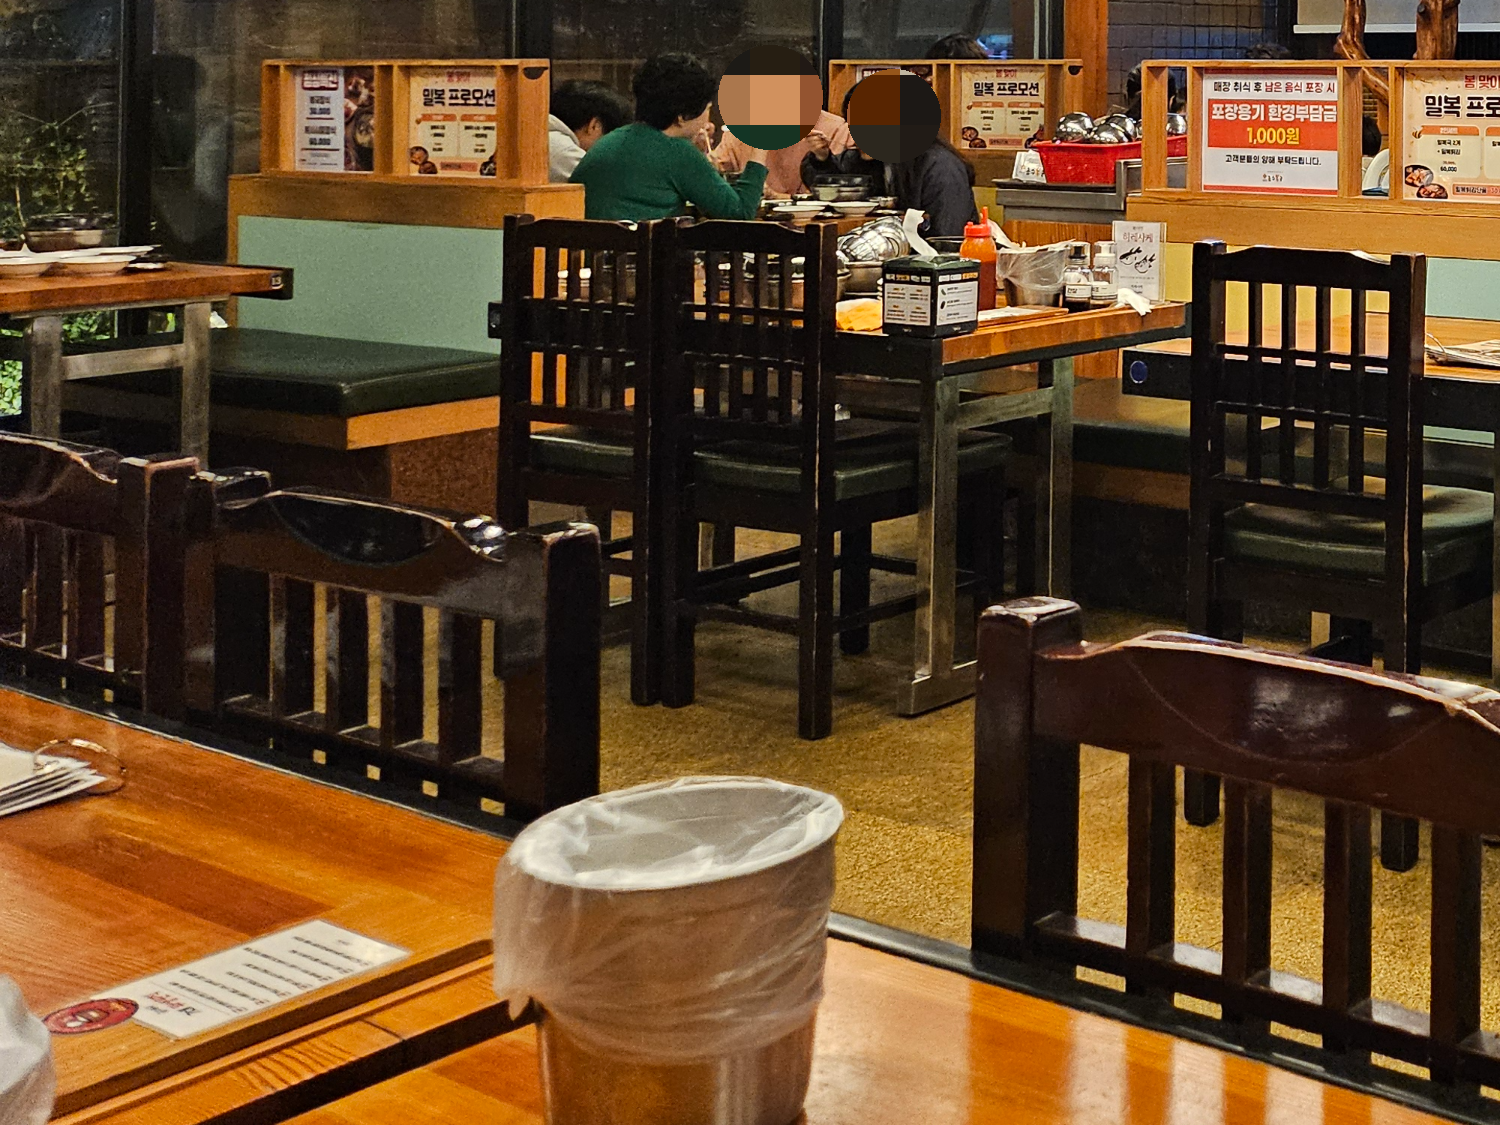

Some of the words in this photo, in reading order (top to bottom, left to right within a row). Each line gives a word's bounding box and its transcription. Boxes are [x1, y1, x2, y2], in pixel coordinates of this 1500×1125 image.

[974, 82, 994, 96] 밀복
[997, 82, 1039, 96] 프로모션
[1214, 81, 1231, 92] 매장
[1233, 81, 1251, 92] 취식
[1254, 82, 1262, 92] 후
[1265, 82, 1282, 93] 남은
[1285, 82, 1302, 93] 음식
[1305, 82, 1323, 93] 포장
[1326, 82, 1335, 93] 시
[1464, 75, 1475, 89] 봄
[1478, 75, 1500, 89] 맞이
[423, 88, 445, 107] 밀복
[448, 88, 495, 107] 프로모션
[1212, 103, 1265, 121] 포장용기
[1268, 104, 1337, 122] 환경부담금
[1425, 95, 1461, 118] 밀복
[1247, 127, 1300, 145] 1,000원
[1225, 154, 1259, 164] 고객분들의
